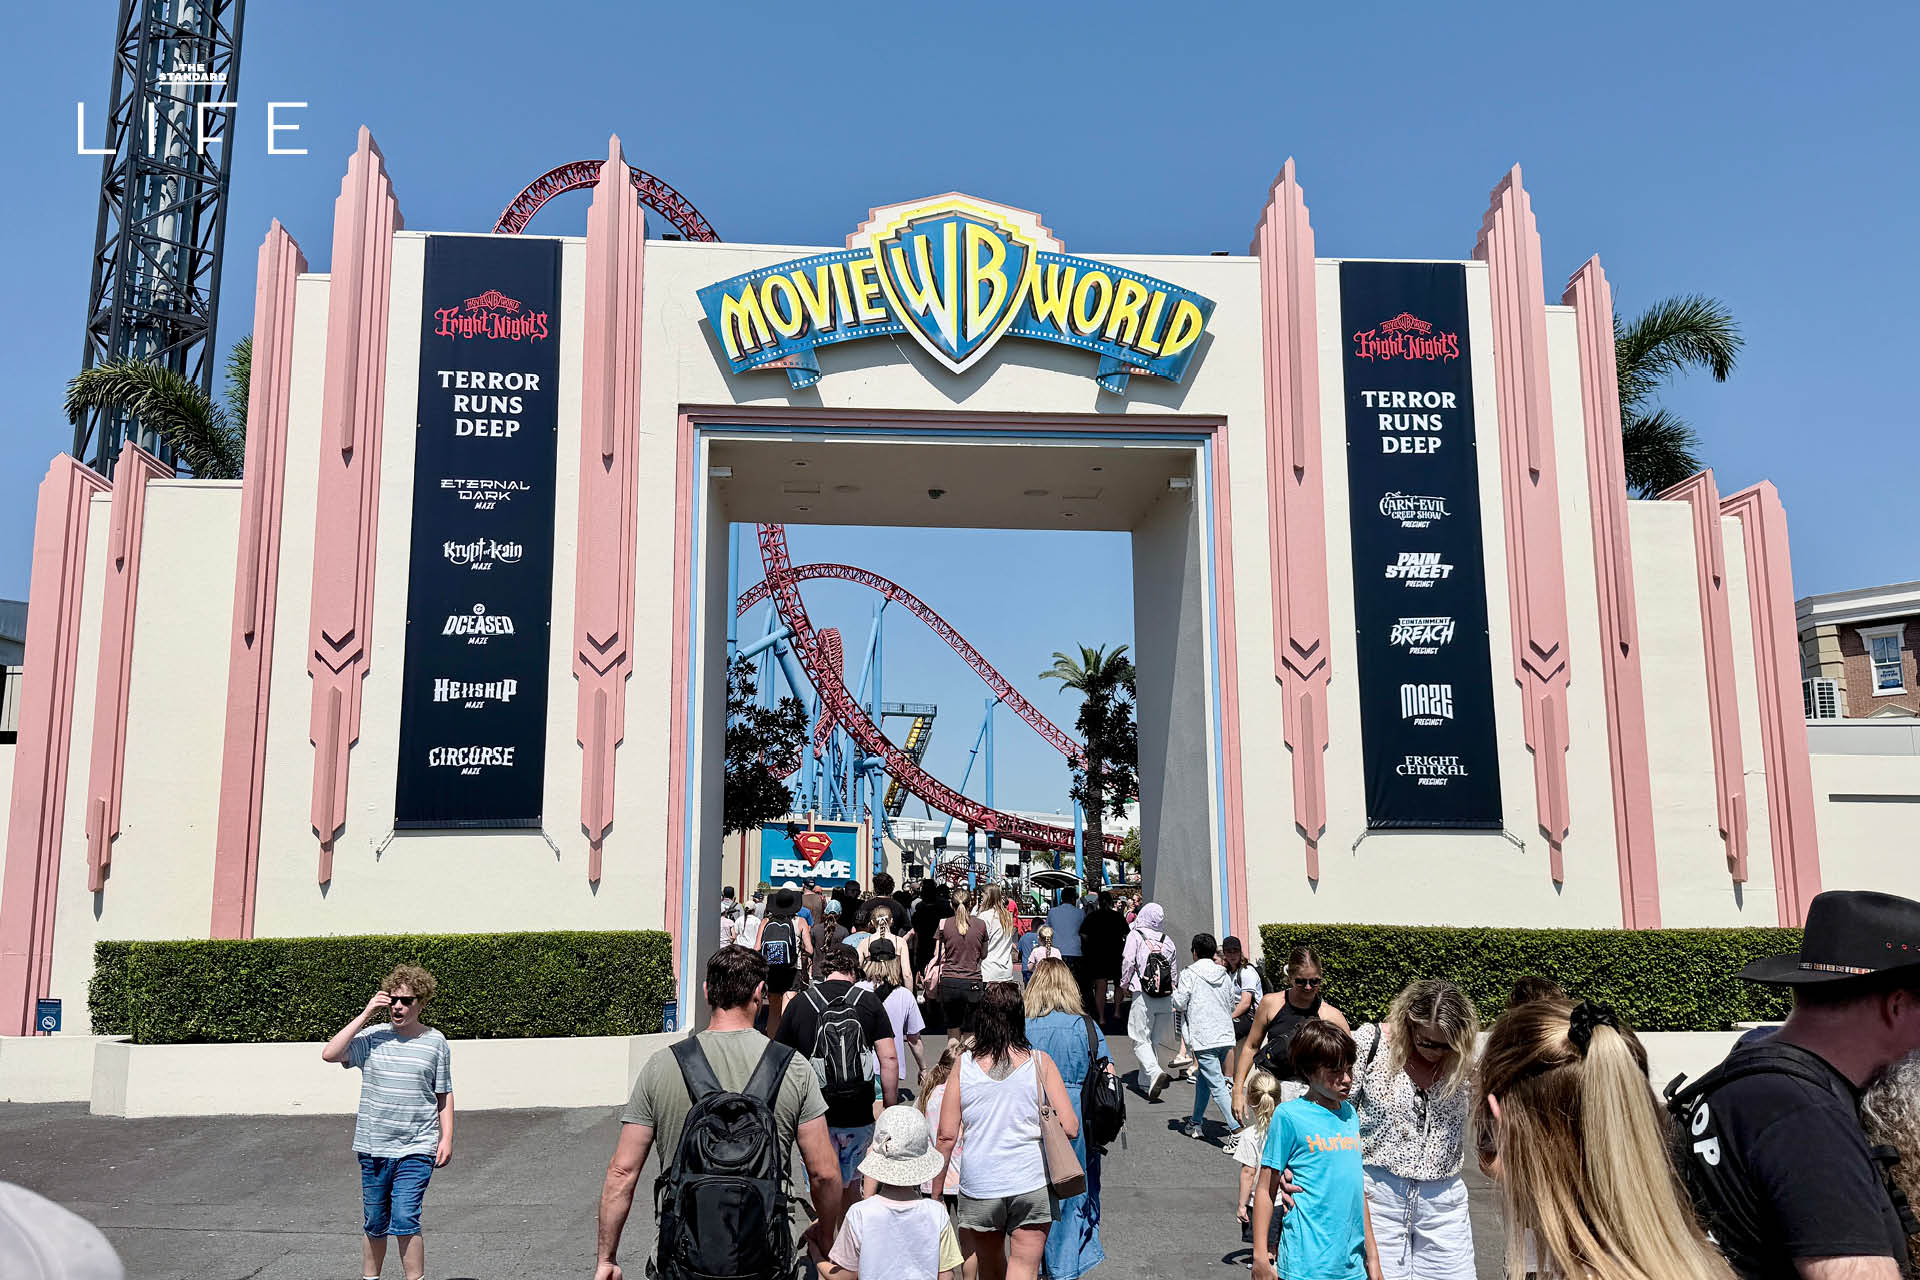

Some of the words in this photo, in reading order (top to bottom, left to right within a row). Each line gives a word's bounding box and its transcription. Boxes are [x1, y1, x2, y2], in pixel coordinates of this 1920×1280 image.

[720, 258, 887, 360] MOVIE
[891, 221, 1008, 352] WB
[1030, 263, 1204, 358] WORLD
[437, 370, 540, 391] TERROR
[453, 394, 523, 414] RUNS
[1361, 390, 1457, 409] TERROR
[455, 418, 520, 438] DEEP
[1378, 413, 1443, 431] RUNS
[1382, 436, 1442, 454] DEEP
[440, 479, 531, 490] ETERNAL
[458, 490, 511, 501] DARK
[474, 502, 497, 510] MAZE
[1391, 511, 1416, 520] CREEP
[1417, 511, 1442, 520] SHOW
[1397, 553, 1441, 566] PAIN
[1385, 565, 1454, 579] STREET
[1405, 580, 1435, 588] PRECINCT
[442, 615, 515, 636] DCEASED
[1390, 620, 1456, 647] BREACH
[467, 637, 489, 645] MAZE
[1409, 647, 1439, 655] PRECINCT
[464, 701, 485, 709] MAZE
[1400, 684, 1454, 719] MAZE
[1413, 718, 1443, 726] PRECINCT
[428, 746, 515, 767] CIRCURSE
[1405, 755, 1459, 765] FRIGHT
[461, 767, 482, 775] MAZE
[1396, 764, 1469, 776] CENTRAL
[1418, 778, 1448, 786] PRECINCT
[770, 858, 851, 879] ESCAPE
